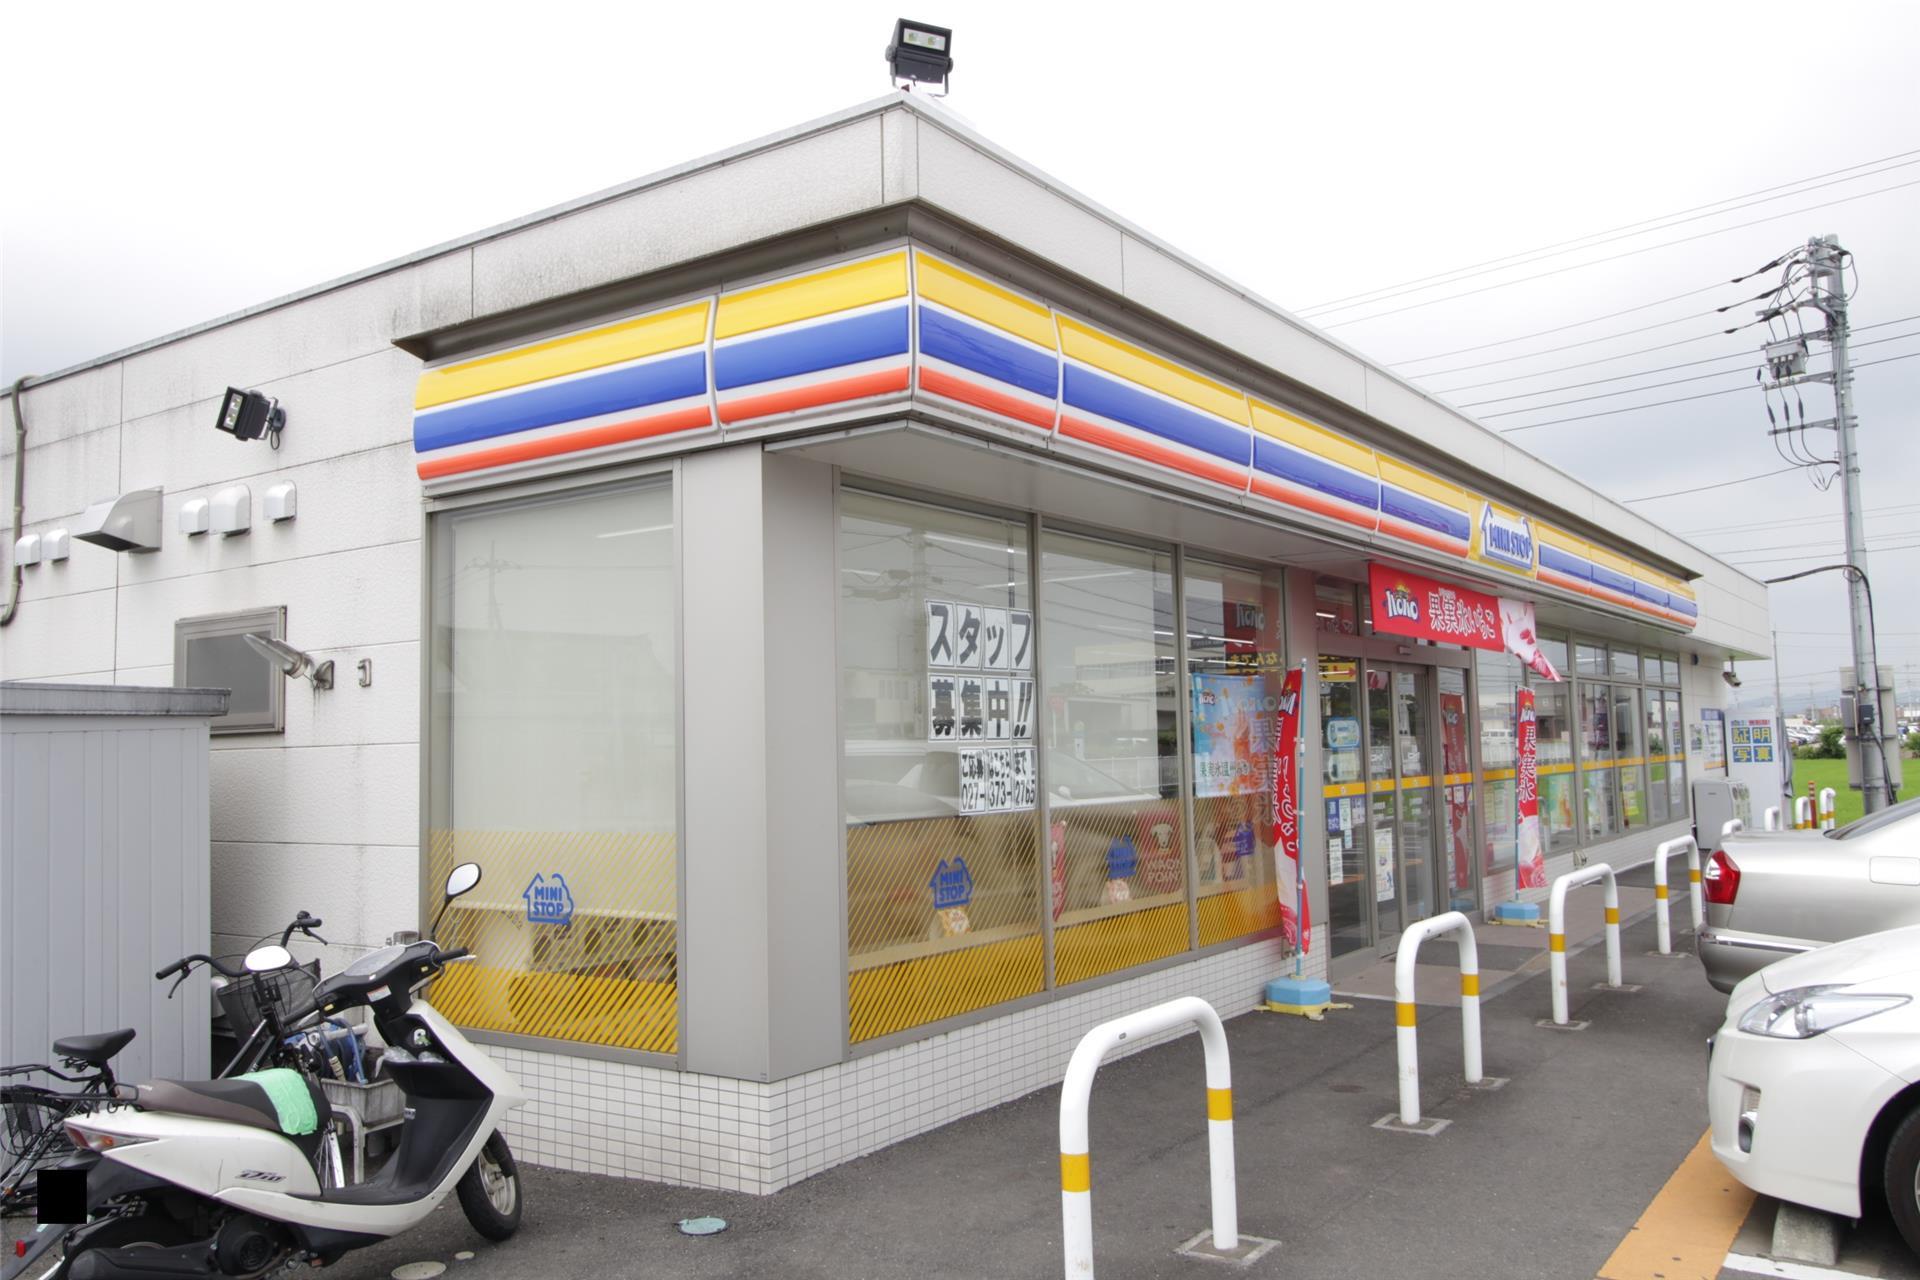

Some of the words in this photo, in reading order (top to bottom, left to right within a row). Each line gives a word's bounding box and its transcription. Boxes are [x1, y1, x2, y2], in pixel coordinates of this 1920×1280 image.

[1489, 523, 1510, 552] MINI
[1511, 530, 1531, 559] STOP
[930, 604, 1031, 667] スタッフ
[1731, 727, 1772, 744] 証明
[535, 886, 562, 901] MINI
[940, 885, 965, 901] STOP
[534, 901, 564, 916] STOP
